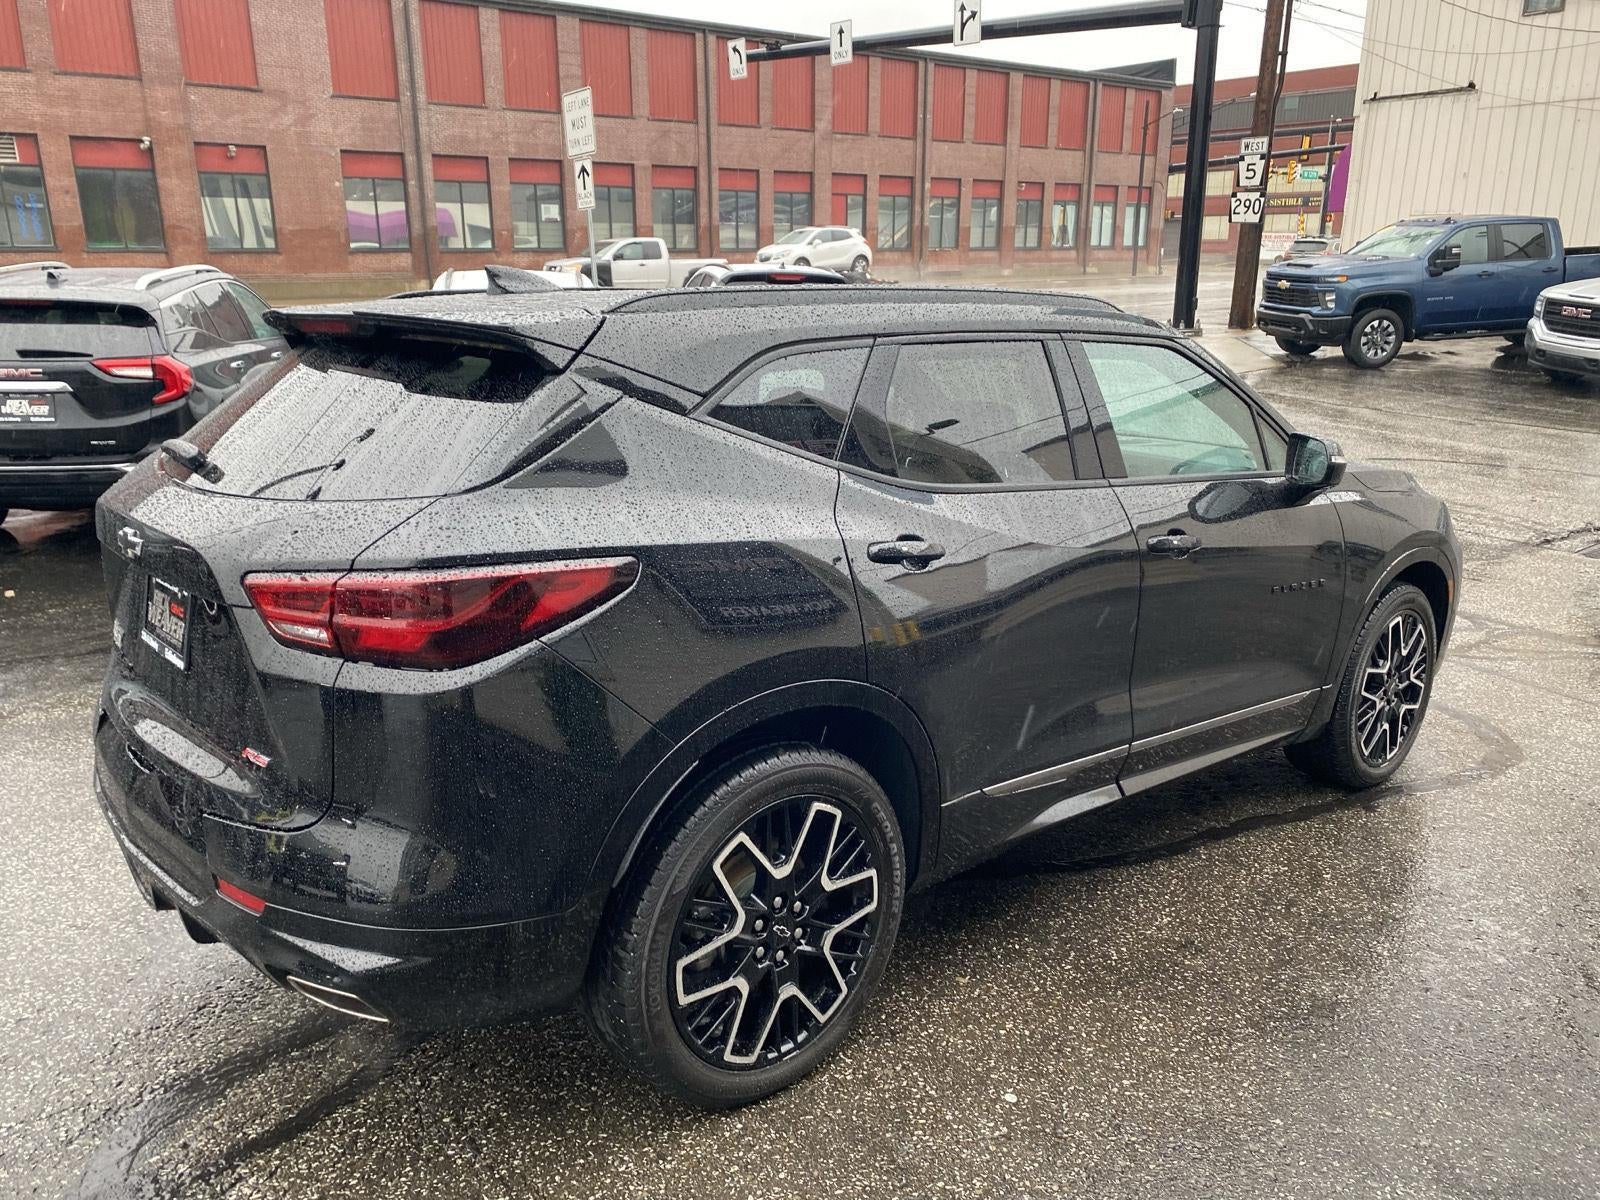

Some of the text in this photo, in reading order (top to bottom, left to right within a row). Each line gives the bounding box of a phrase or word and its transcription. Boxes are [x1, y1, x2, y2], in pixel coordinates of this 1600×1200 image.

[833, 50, 848, 61] ONLY
[732, 67, 744, 76] ONLY
[565, 96, 590, 113] LEFT LANE
[571, 116, 587, 130] MUST
[581, 134, 593, 146] LEFT
[1244, 141, 1265, 152] WEST
[1245, 163, 1257, 180] 5
[1232, 198, 1262, 215] 290
[1561, 306, 1592, 318] GMC
[1, 405, 49, 416] WEAVER
[1271, 578, 1327, 593] BLAZER
[148, 601, 185, 642] WEAVER
[241, 747, 271, 768] RS
[872, 802, 901, 912] GEOLANDAR
